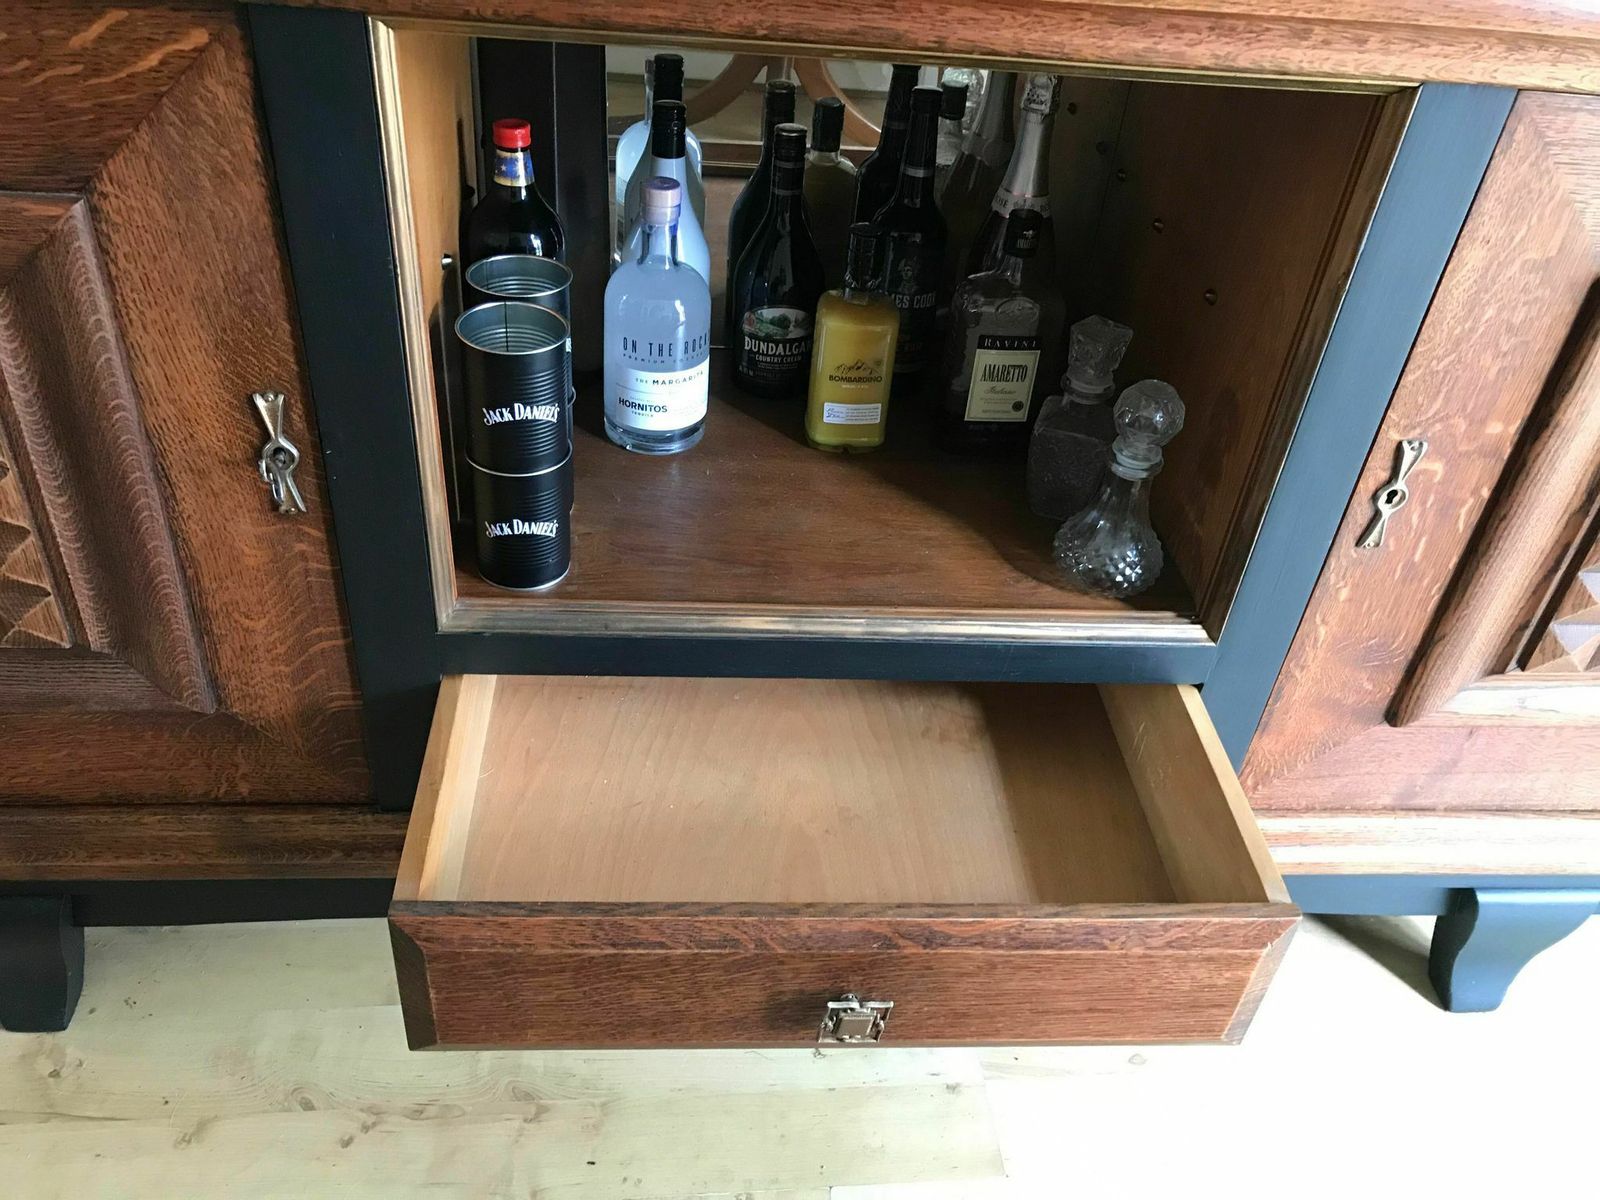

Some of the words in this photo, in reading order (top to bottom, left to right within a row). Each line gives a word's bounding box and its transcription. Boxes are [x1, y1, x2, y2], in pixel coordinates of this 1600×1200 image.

[622, 337, 637, 354] ON
[648, 343, 673, 356] THE
[755, 354, 782, 364] COUNTRY
[652, 369, 704, 386] MARGARITA
[828, 374, 883, 383] BOMBARDINO
[979, 364, 1028, 382] AMARETTO
[618, 396, 668, 413] HORNITOS
[481, 406, 514, 426] JACK
[513, 402, 561, 424] DANIEL'S
[485, 520, 513, 538] JACK
[512, 518, 560, 538] DANIEL'S
